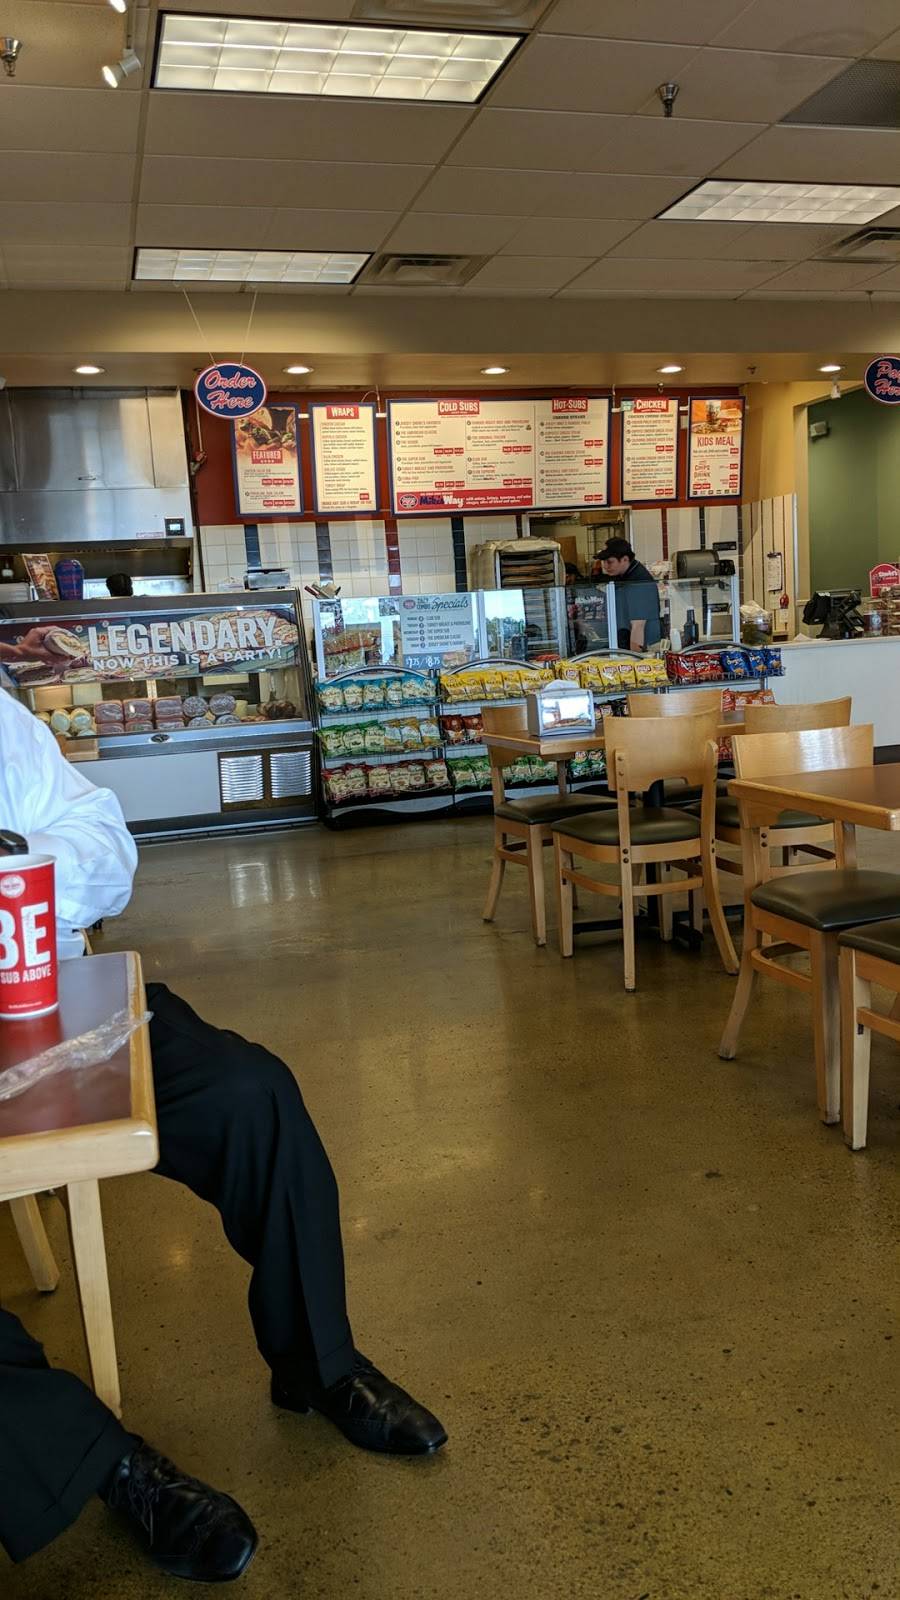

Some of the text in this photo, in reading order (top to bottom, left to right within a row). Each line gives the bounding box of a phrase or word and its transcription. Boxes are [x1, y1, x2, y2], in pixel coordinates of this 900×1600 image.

[204, 370, 256, 389] Order
[206, 390, 254, 409] Here
[568, 399, 586, 410] SUBS
[636, 399, 667, 409] CHICKEN
[331, 407, 355, 417] WRAPS
[440, 401, 478, 412] COLD SUBS
[697, 436, 734, 447] KIDS MEAL
[252, 450, 281, 460] FEATURED
[443, 495, 464, 508] Way
[431, 596, 469, 612] Specials
[88, 616, 282, 658] LEGENDARY.
[93, 648, 282, 671] NOW THIS IS A PARTY!
[0, 964, 52, 984] SUB ABOVE
